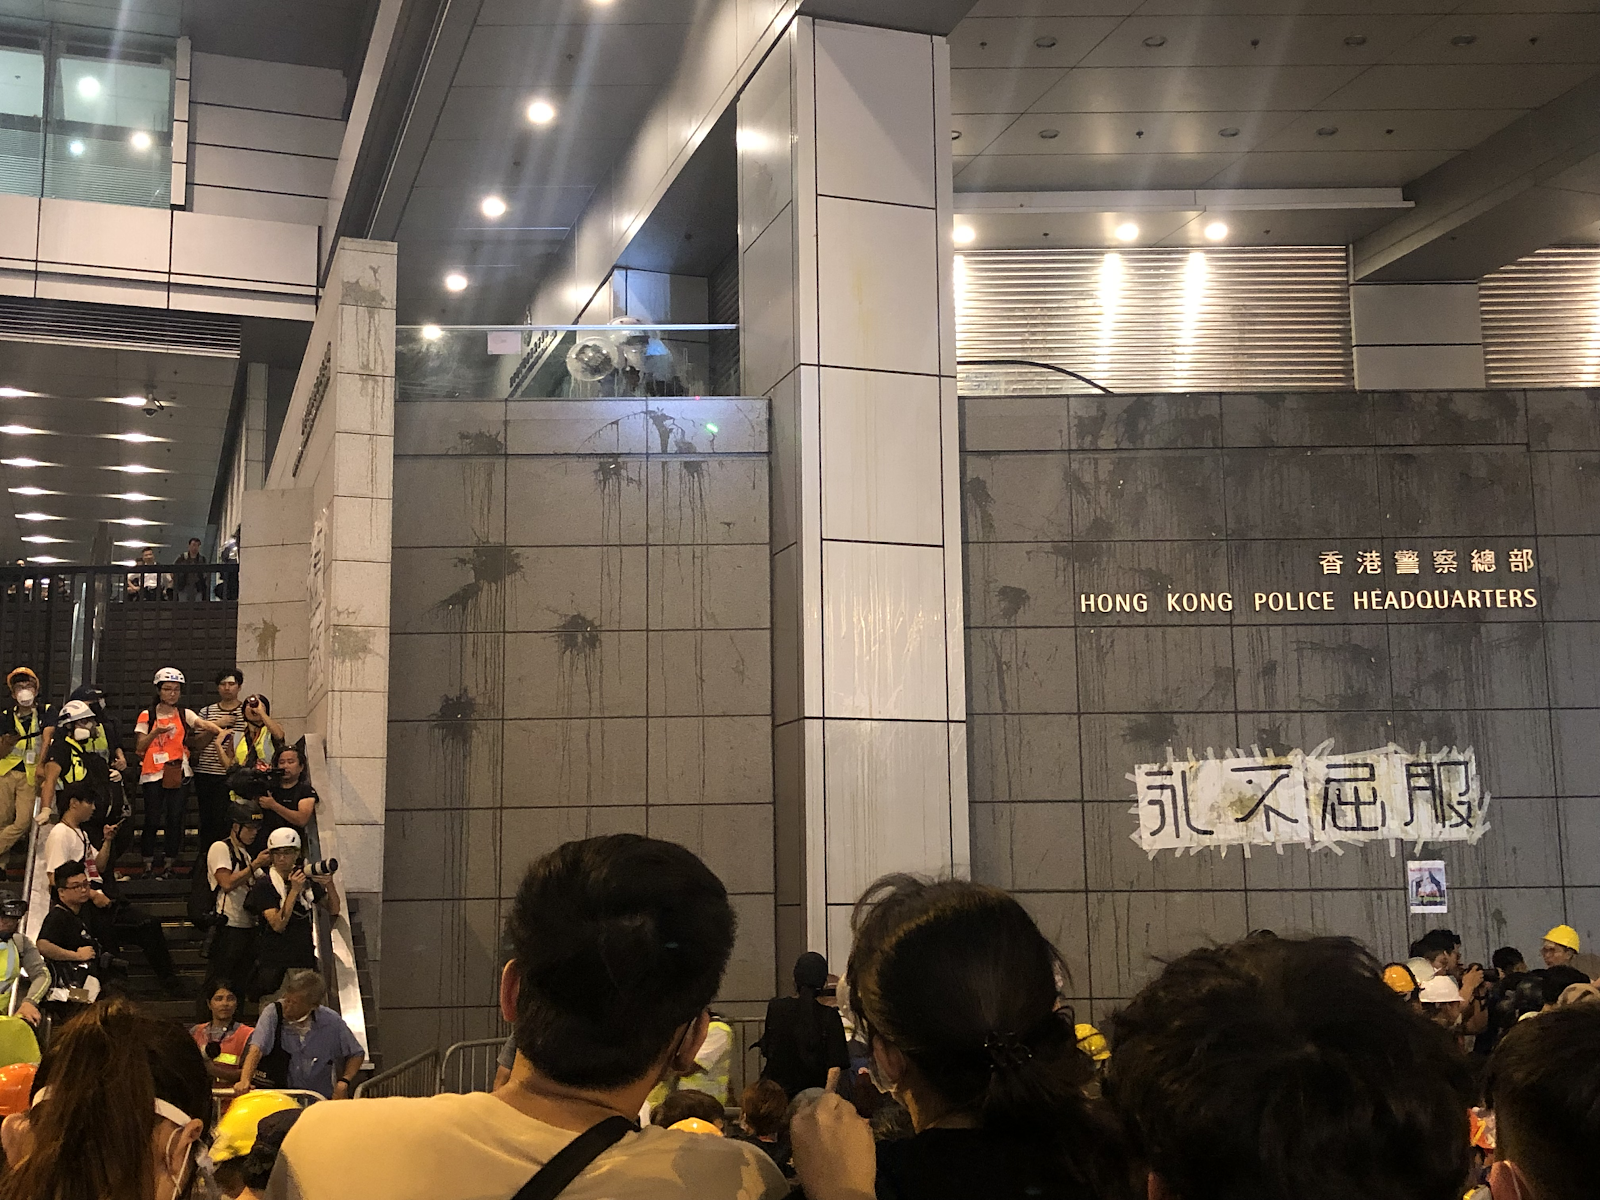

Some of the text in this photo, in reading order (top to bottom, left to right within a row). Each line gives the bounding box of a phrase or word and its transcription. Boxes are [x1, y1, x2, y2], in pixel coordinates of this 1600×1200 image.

[1318, 548, 1535, 575] 香港警察總部
[1080, 588, 1538, 613] HONG KONG POLICE HEADQUARTERS
[1144, 760, 1474, 839] 永不屈服
